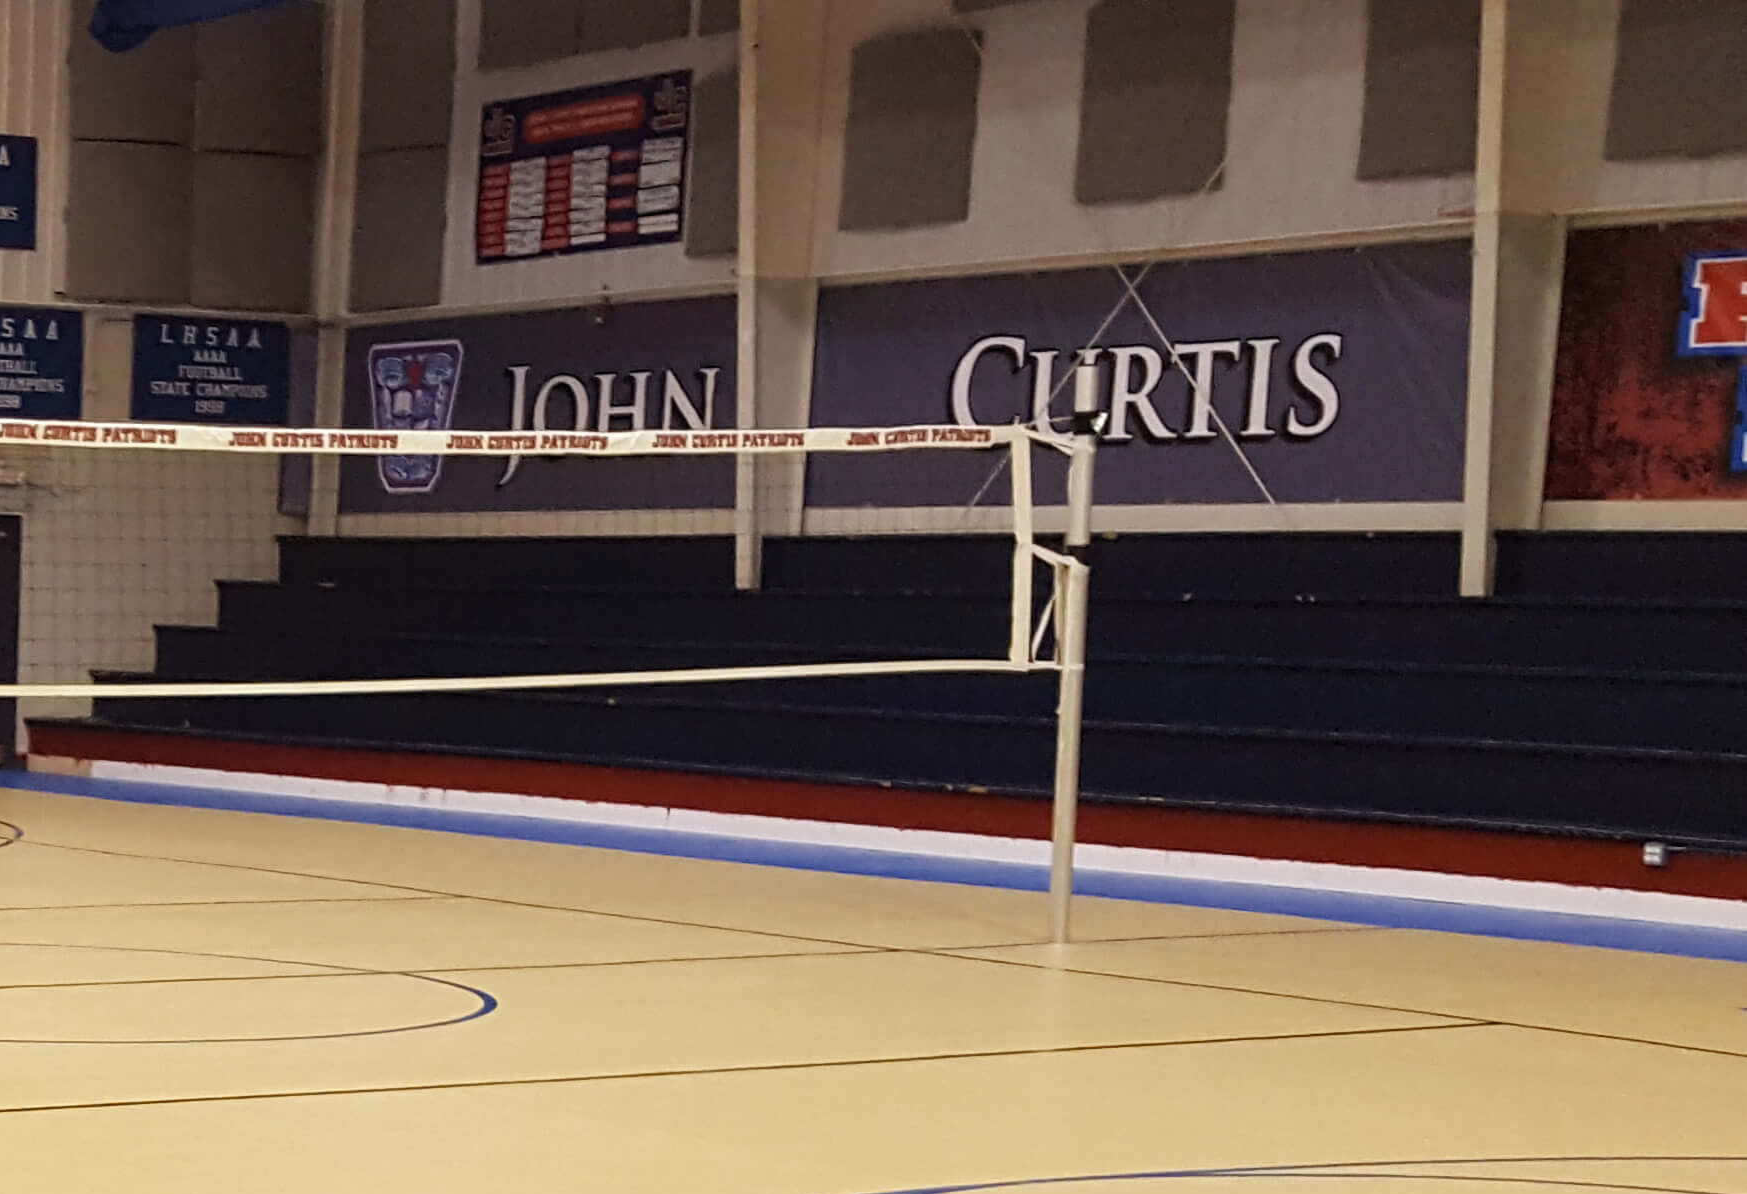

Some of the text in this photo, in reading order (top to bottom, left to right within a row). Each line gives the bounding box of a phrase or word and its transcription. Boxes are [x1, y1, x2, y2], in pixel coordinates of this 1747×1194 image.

[151, 381, 268, 398] STATE CHAMPIONS
[952, 334, 1342, 441] CURTIS
[496, 366, 720, 487] JOHN
[229, 431, 398, 449] JOHN CURTIS PATRIOTS
[652, 433, 805, 448] JOHN CURTIS PATRIOTS
